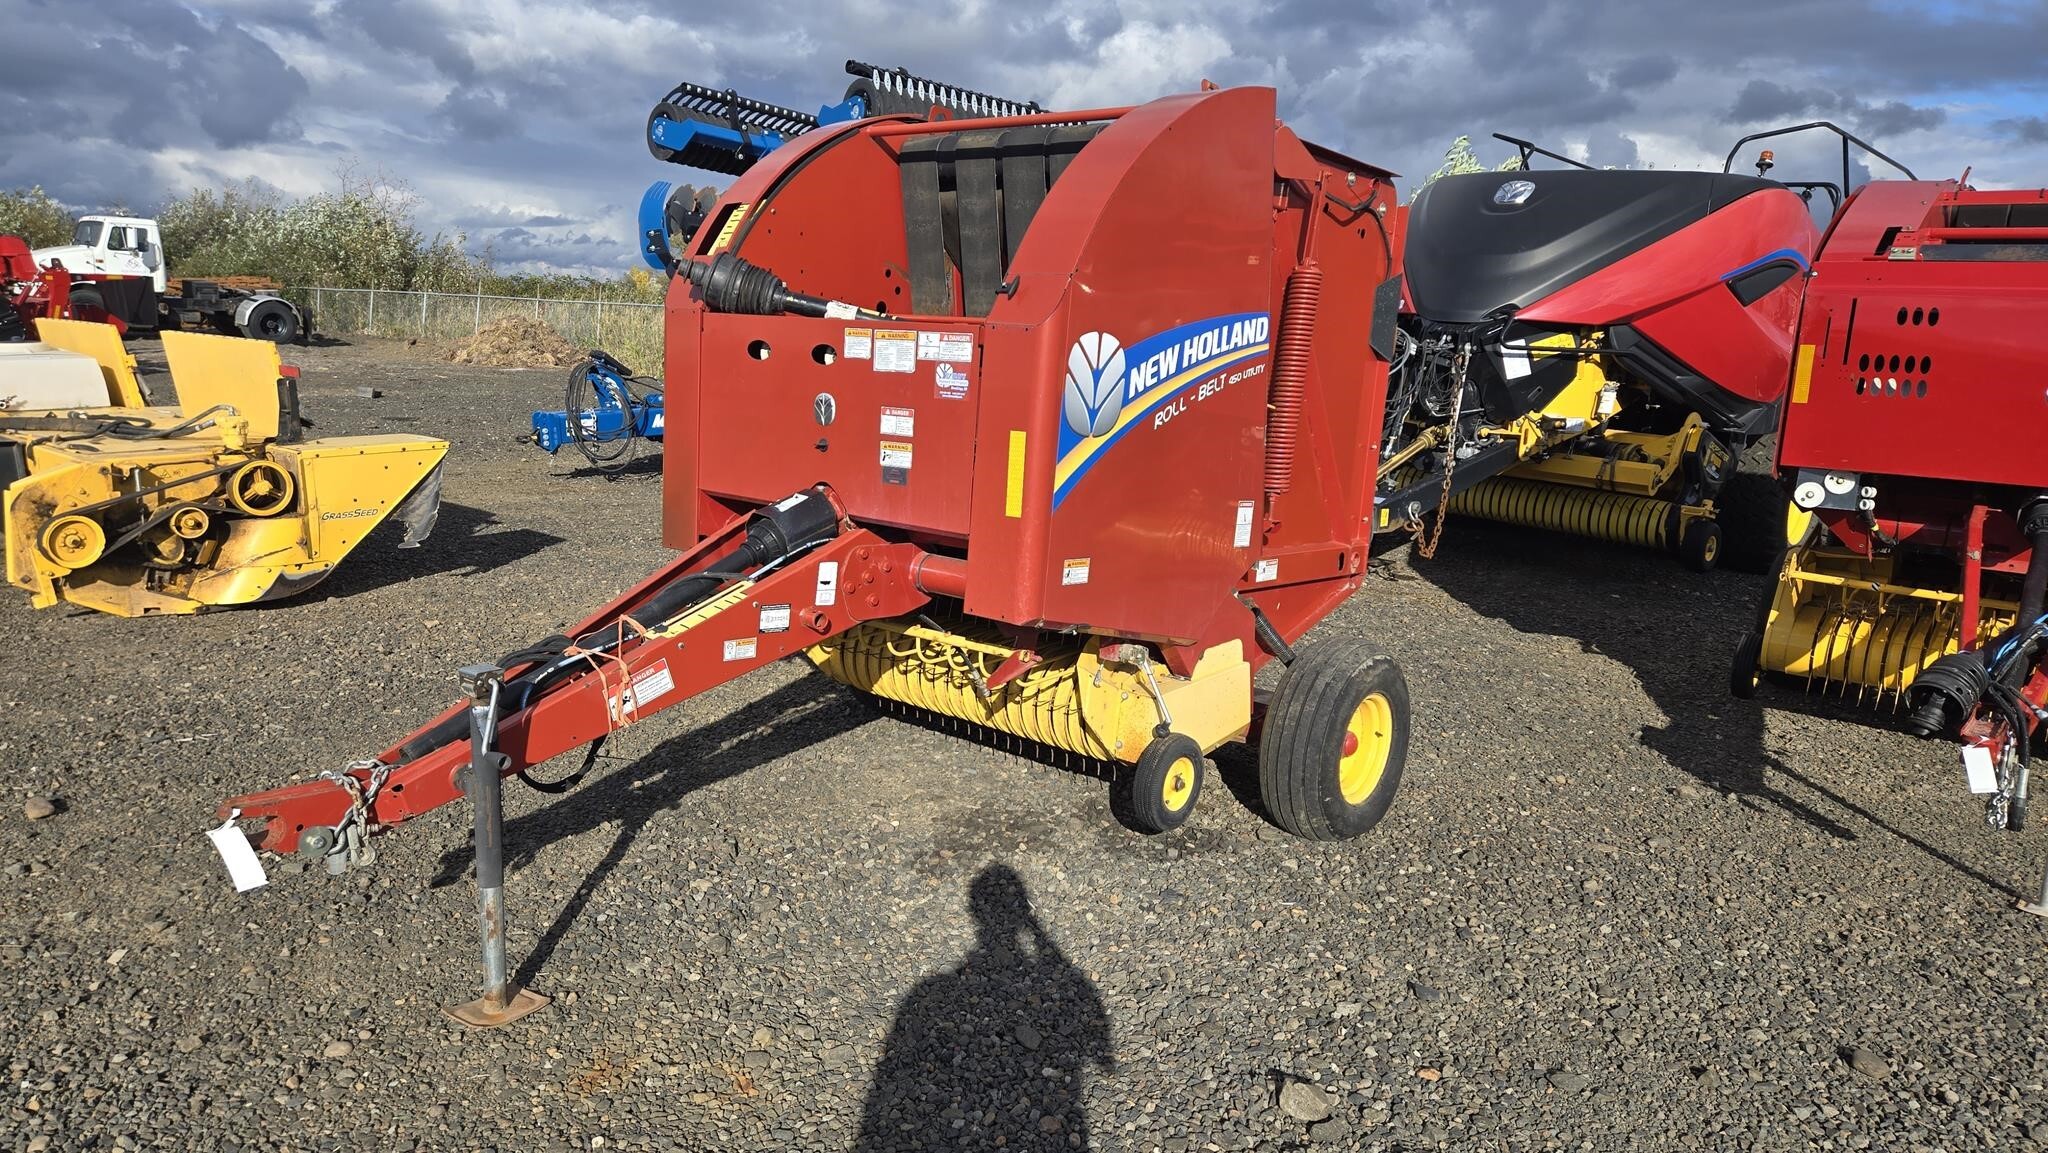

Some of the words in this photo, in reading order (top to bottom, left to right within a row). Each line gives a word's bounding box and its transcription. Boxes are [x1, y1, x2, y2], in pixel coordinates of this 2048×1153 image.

[1128, 343, 1180, 399] NEW
[1182, 316, 1269, 369] HOLLAND
[1154, 397, 1187, 430] ROLL
[1198, 373, 1227, 402] BELT
[1243, 363, 1265, 379] UTILITY
[630, 667, 656, 684] ANGER
